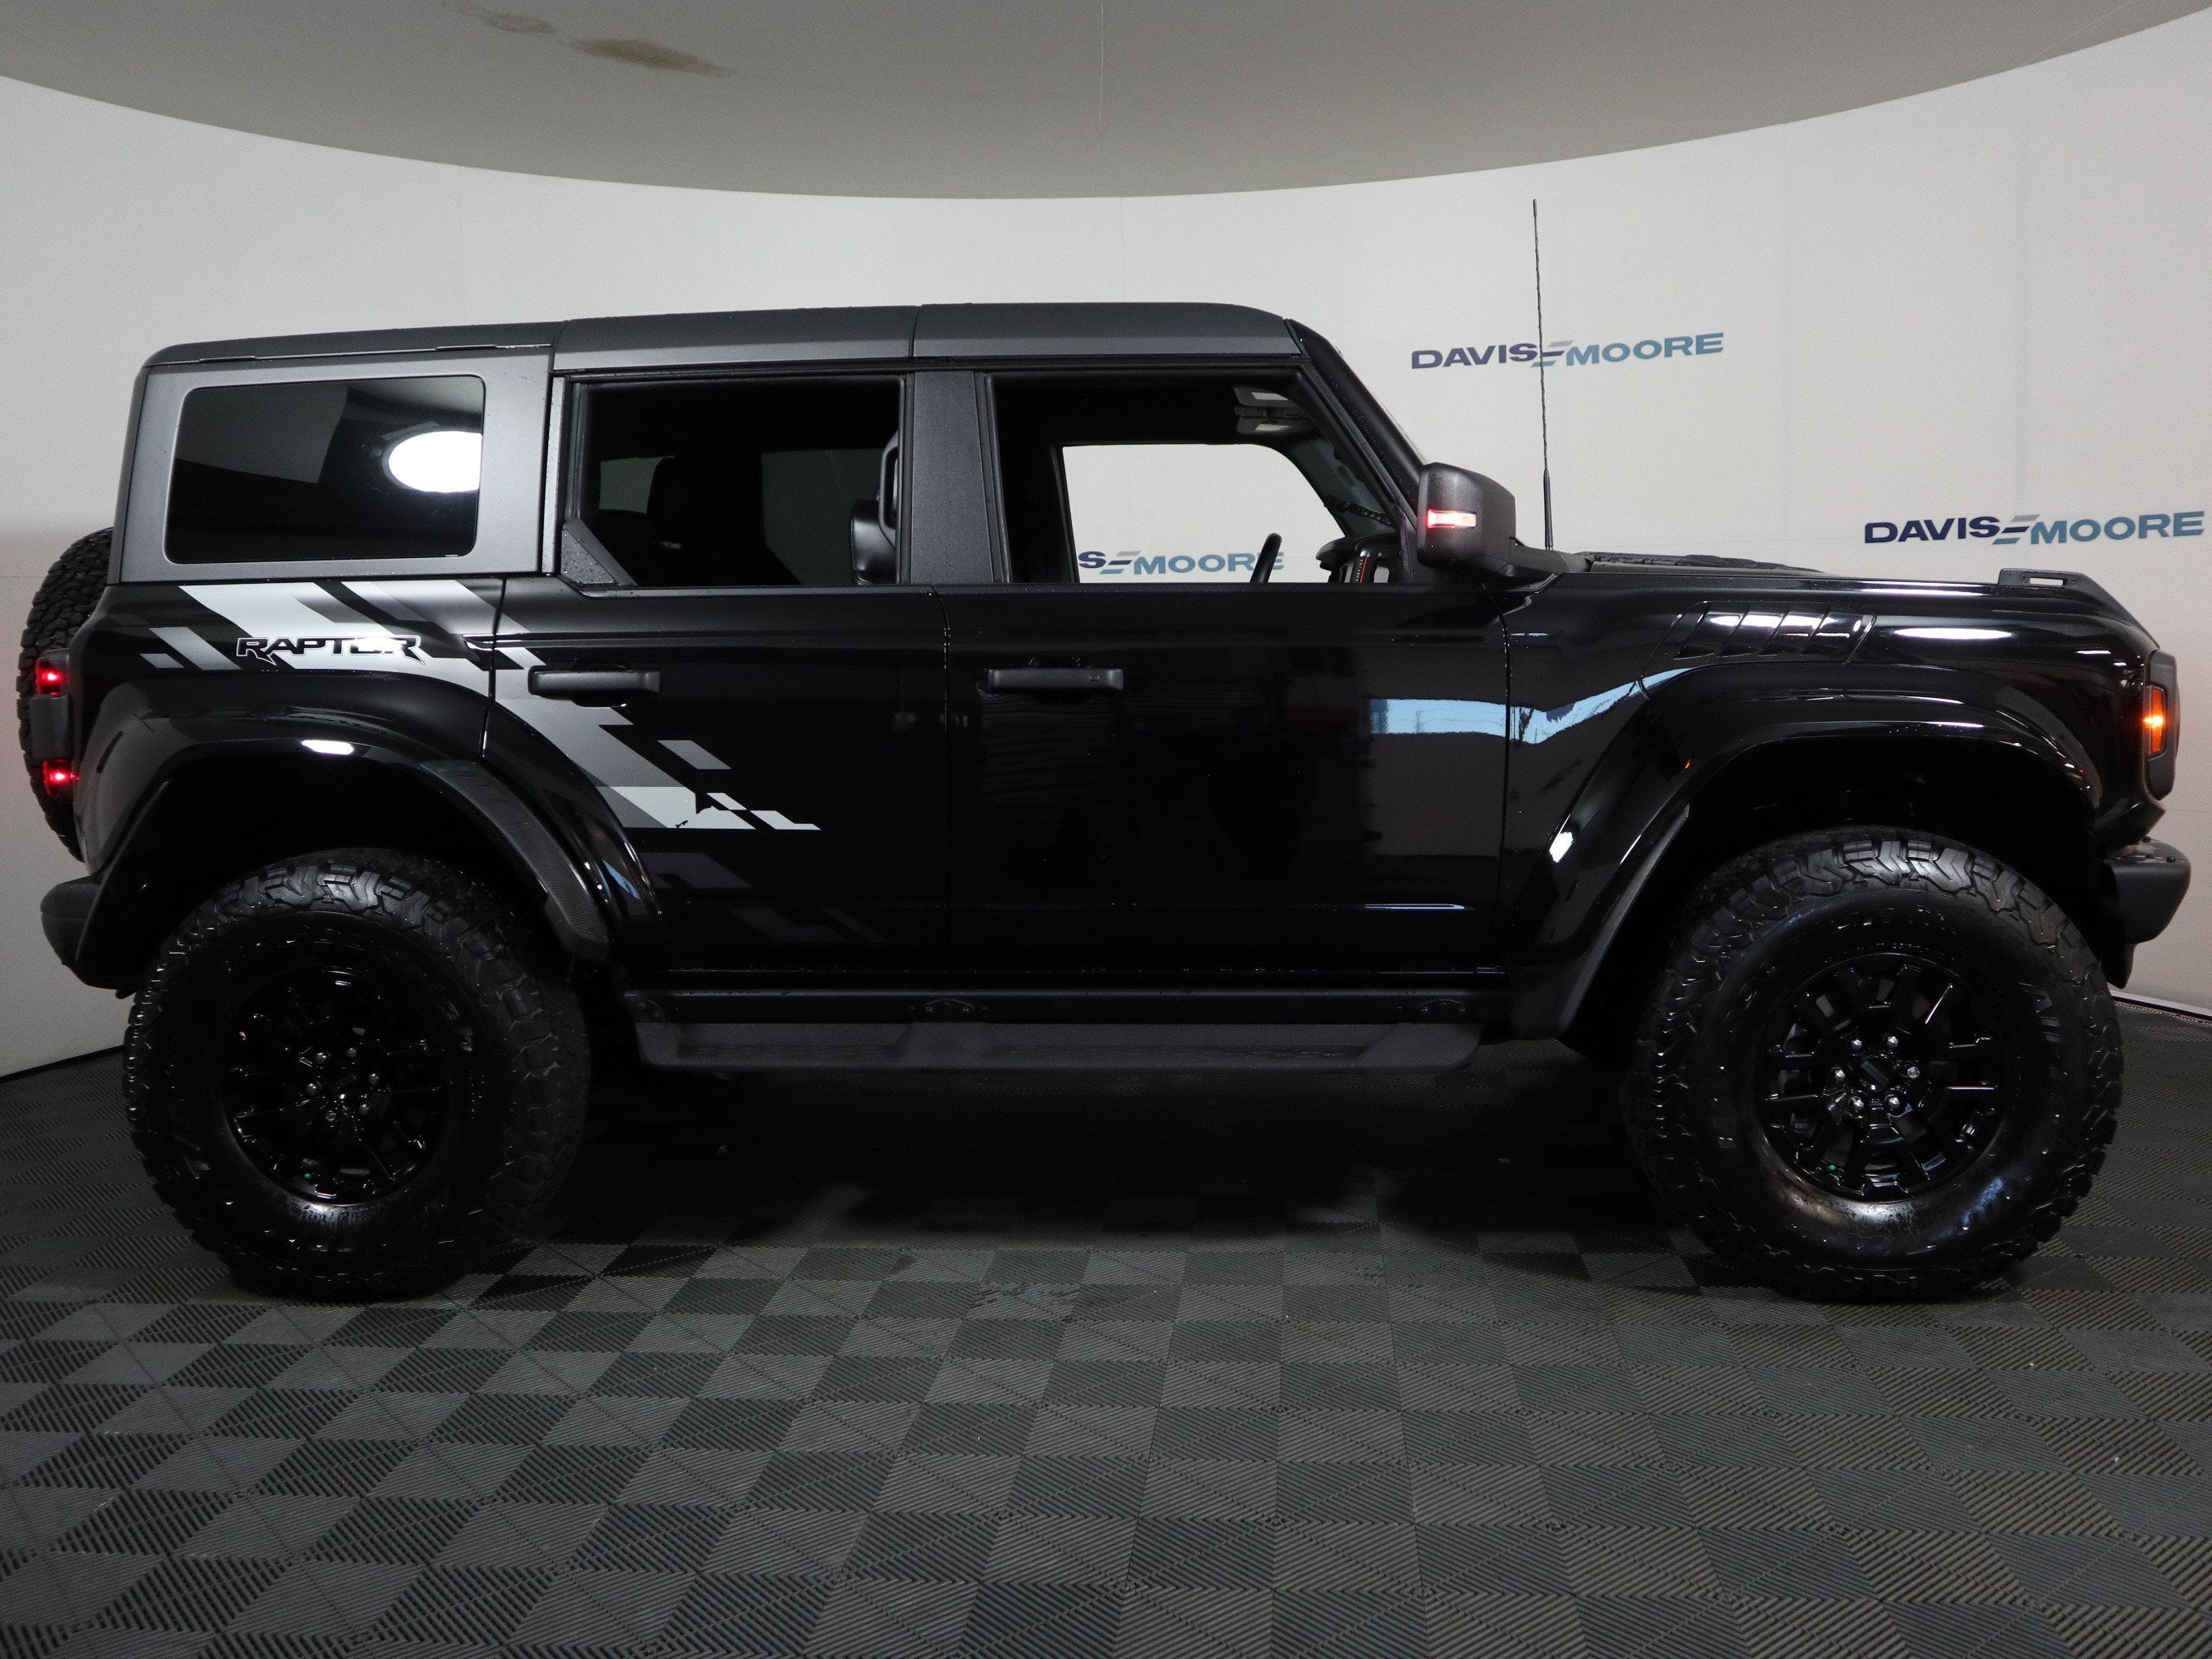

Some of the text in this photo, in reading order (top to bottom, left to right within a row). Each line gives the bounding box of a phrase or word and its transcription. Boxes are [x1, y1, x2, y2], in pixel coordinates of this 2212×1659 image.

[1412, 332, 1724, 369] DAVIS MOORE
[1865, 511, 2205, 545] DAVIS MOORE
